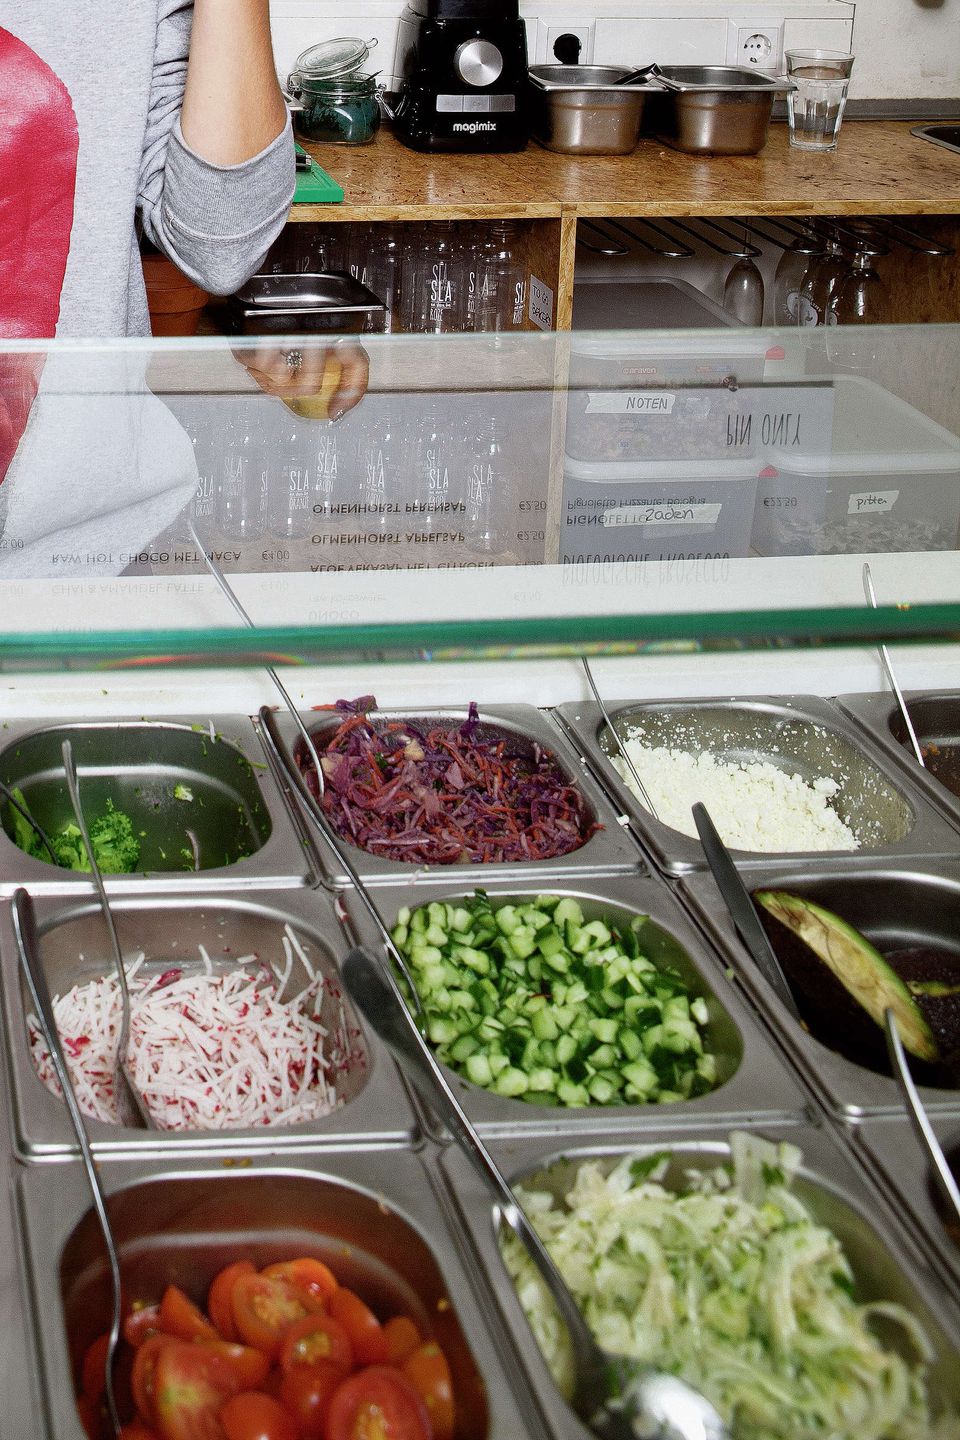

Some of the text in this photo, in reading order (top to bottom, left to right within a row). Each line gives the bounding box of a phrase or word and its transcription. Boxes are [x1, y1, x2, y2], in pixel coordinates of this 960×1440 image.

[452, 120, 497, 134] magimix
[430, 279, 452, 302] SLA
[626, 396, 669, 410] NOTEN
